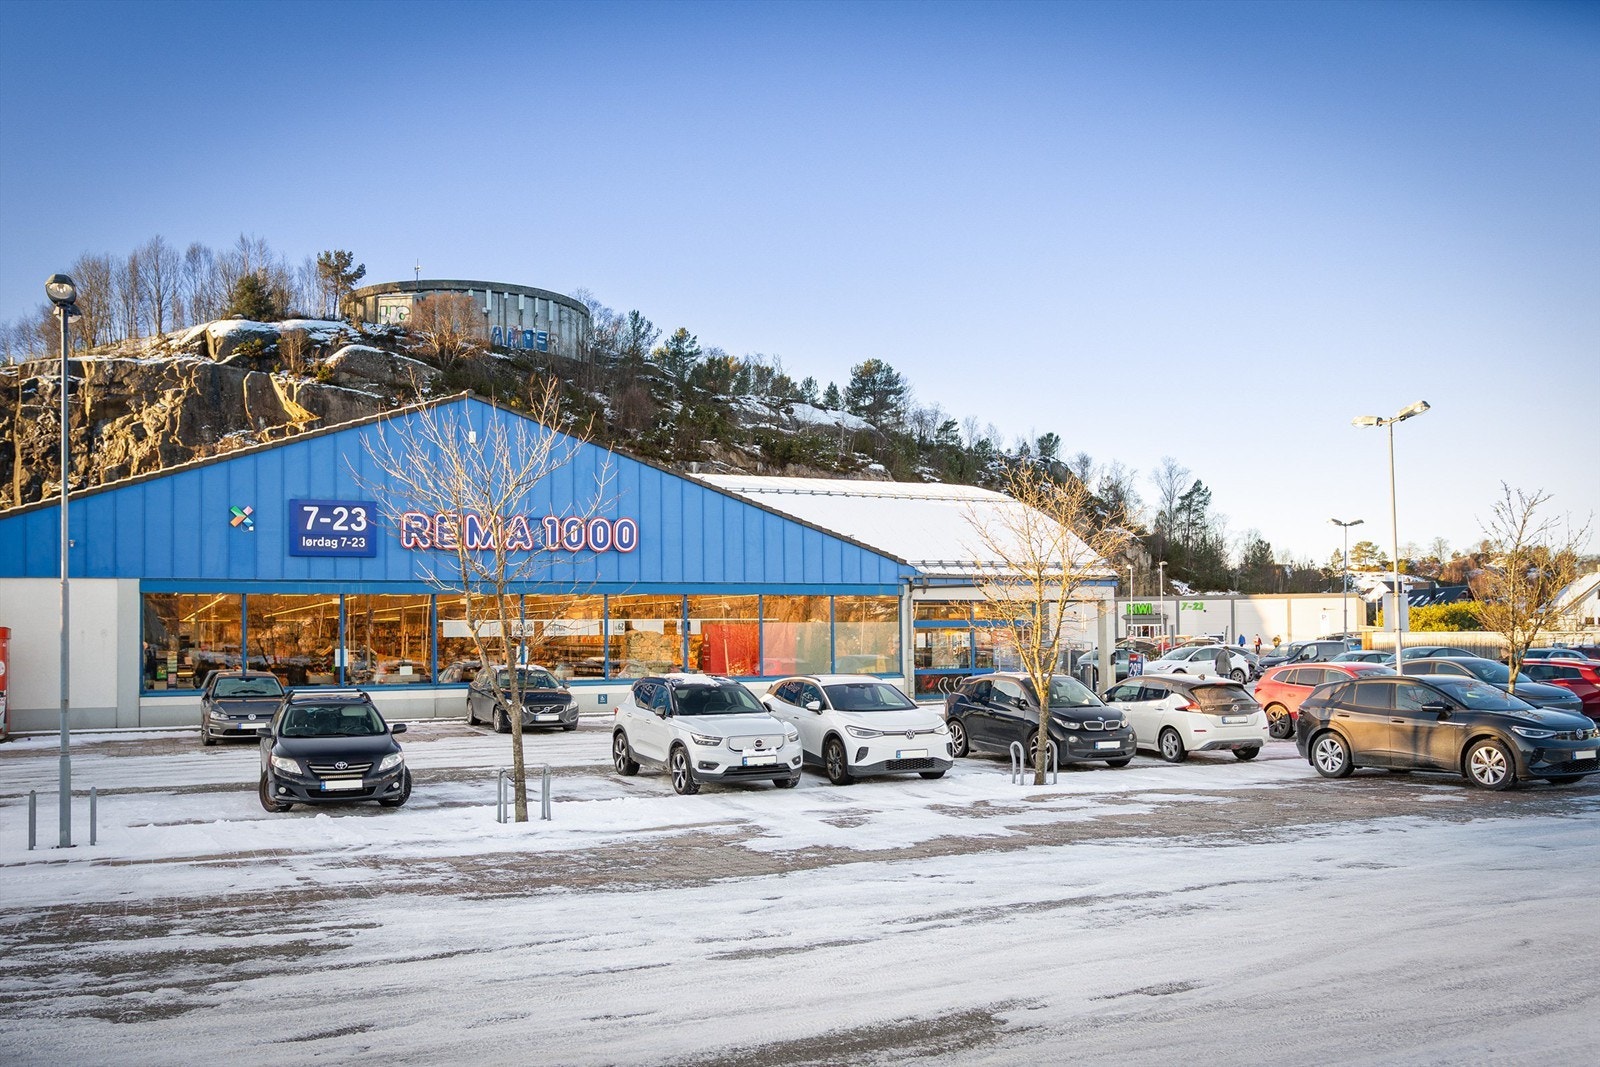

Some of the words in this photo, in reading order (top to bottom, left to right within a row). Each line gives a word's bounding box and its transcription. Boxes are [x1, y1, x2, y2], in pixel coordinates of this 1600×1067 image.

[303, 506, 367, 531] 7-23
[401, 512, 532, 549] REMA
[543, 516, 638, 552] 1000
[302, 536, 338, 549] lørdag
[340, 537, 366, 548] 7-23
[1126, 603, 1152, 615] KIWI
